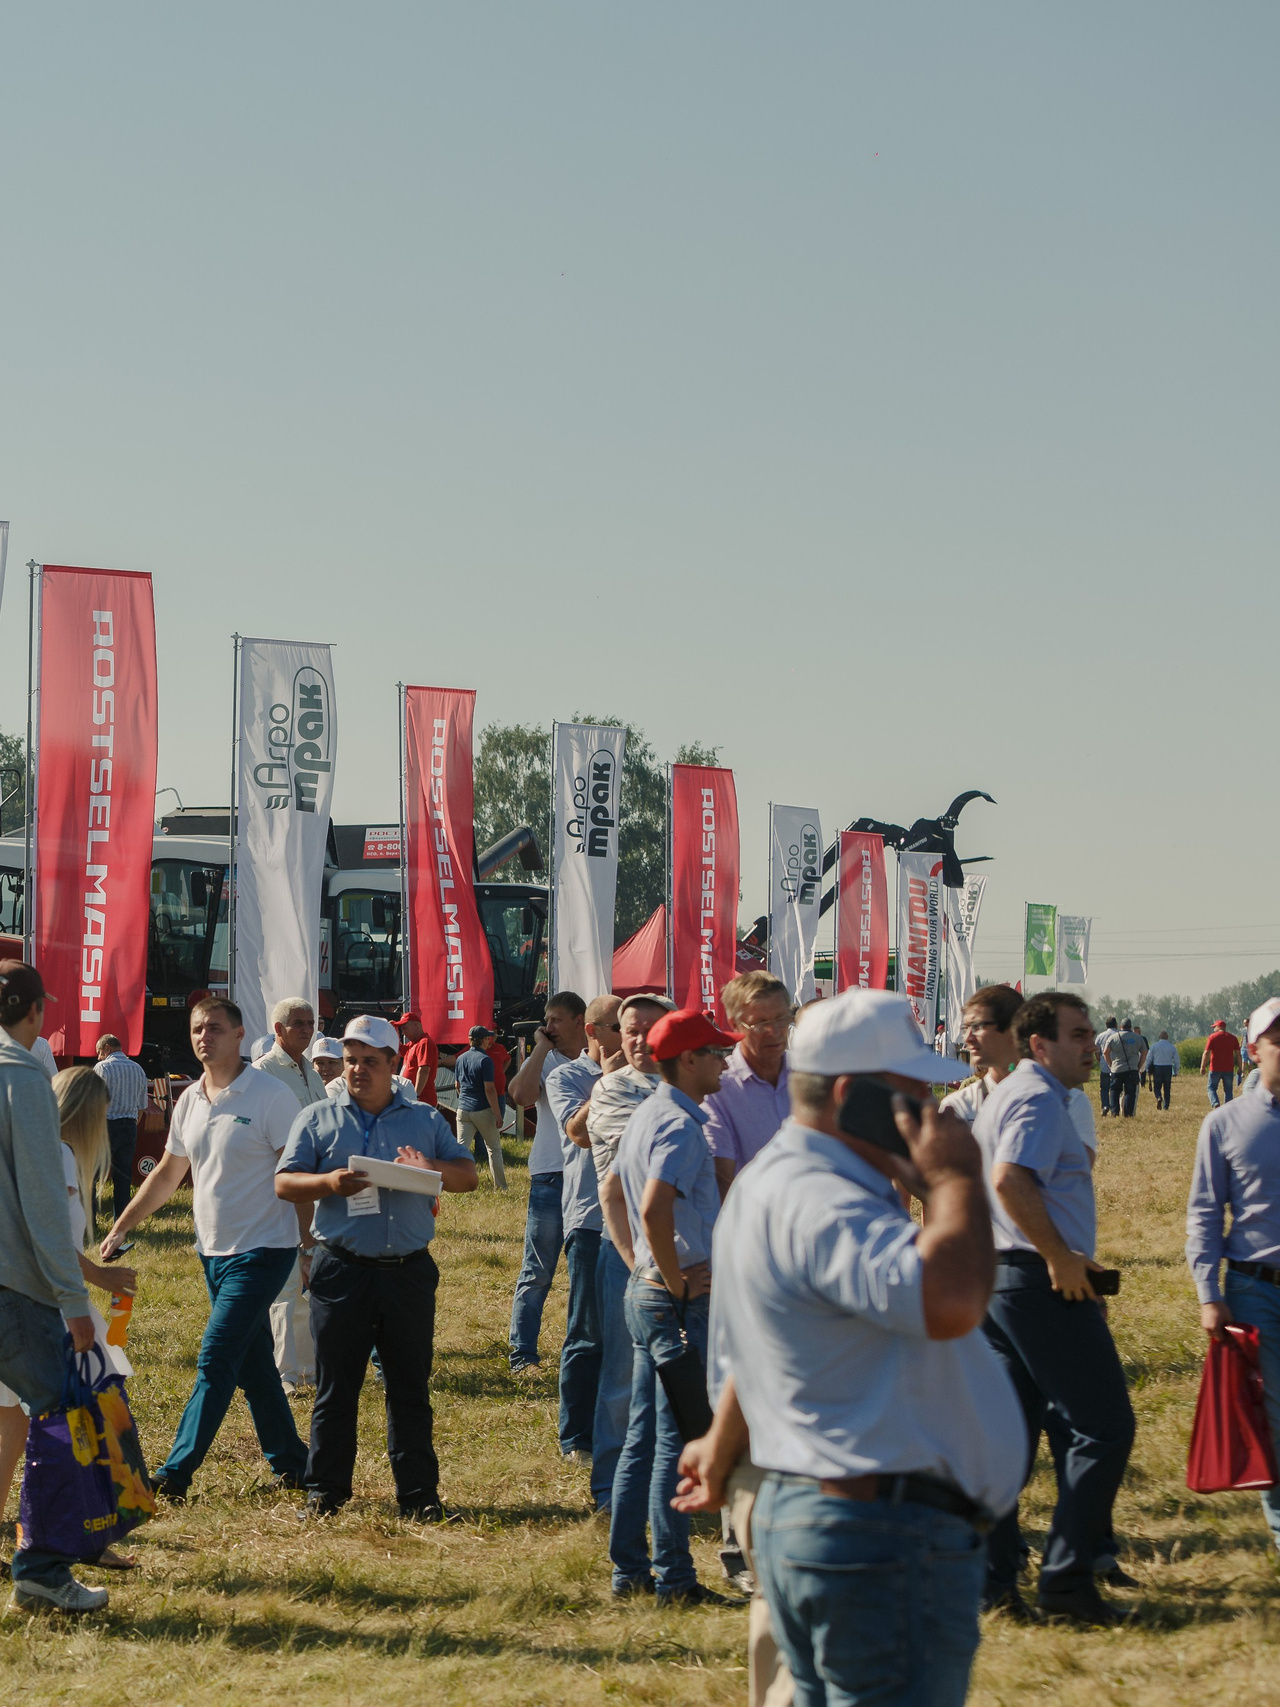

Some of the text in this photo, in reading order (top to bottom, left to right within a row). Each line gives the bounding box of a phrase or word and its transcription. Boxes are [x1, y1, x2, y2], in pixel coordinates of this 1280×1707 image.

[253, 703, 295, 789] Агро
[80, 609, 116, 1023] ROSTSELMASH
[431, 718, 465, 1020] ROSTSELMASH
[700, 788, 716, 1017] ROSTSELMASH
[859, 849, 873, 990] ROSTSELMA
[906, 877, 929, 999] MANITOU
[925, 881, 939, 1001] HANDLING YOUR WORLD
[141, 1160, 154, 1173] 20
